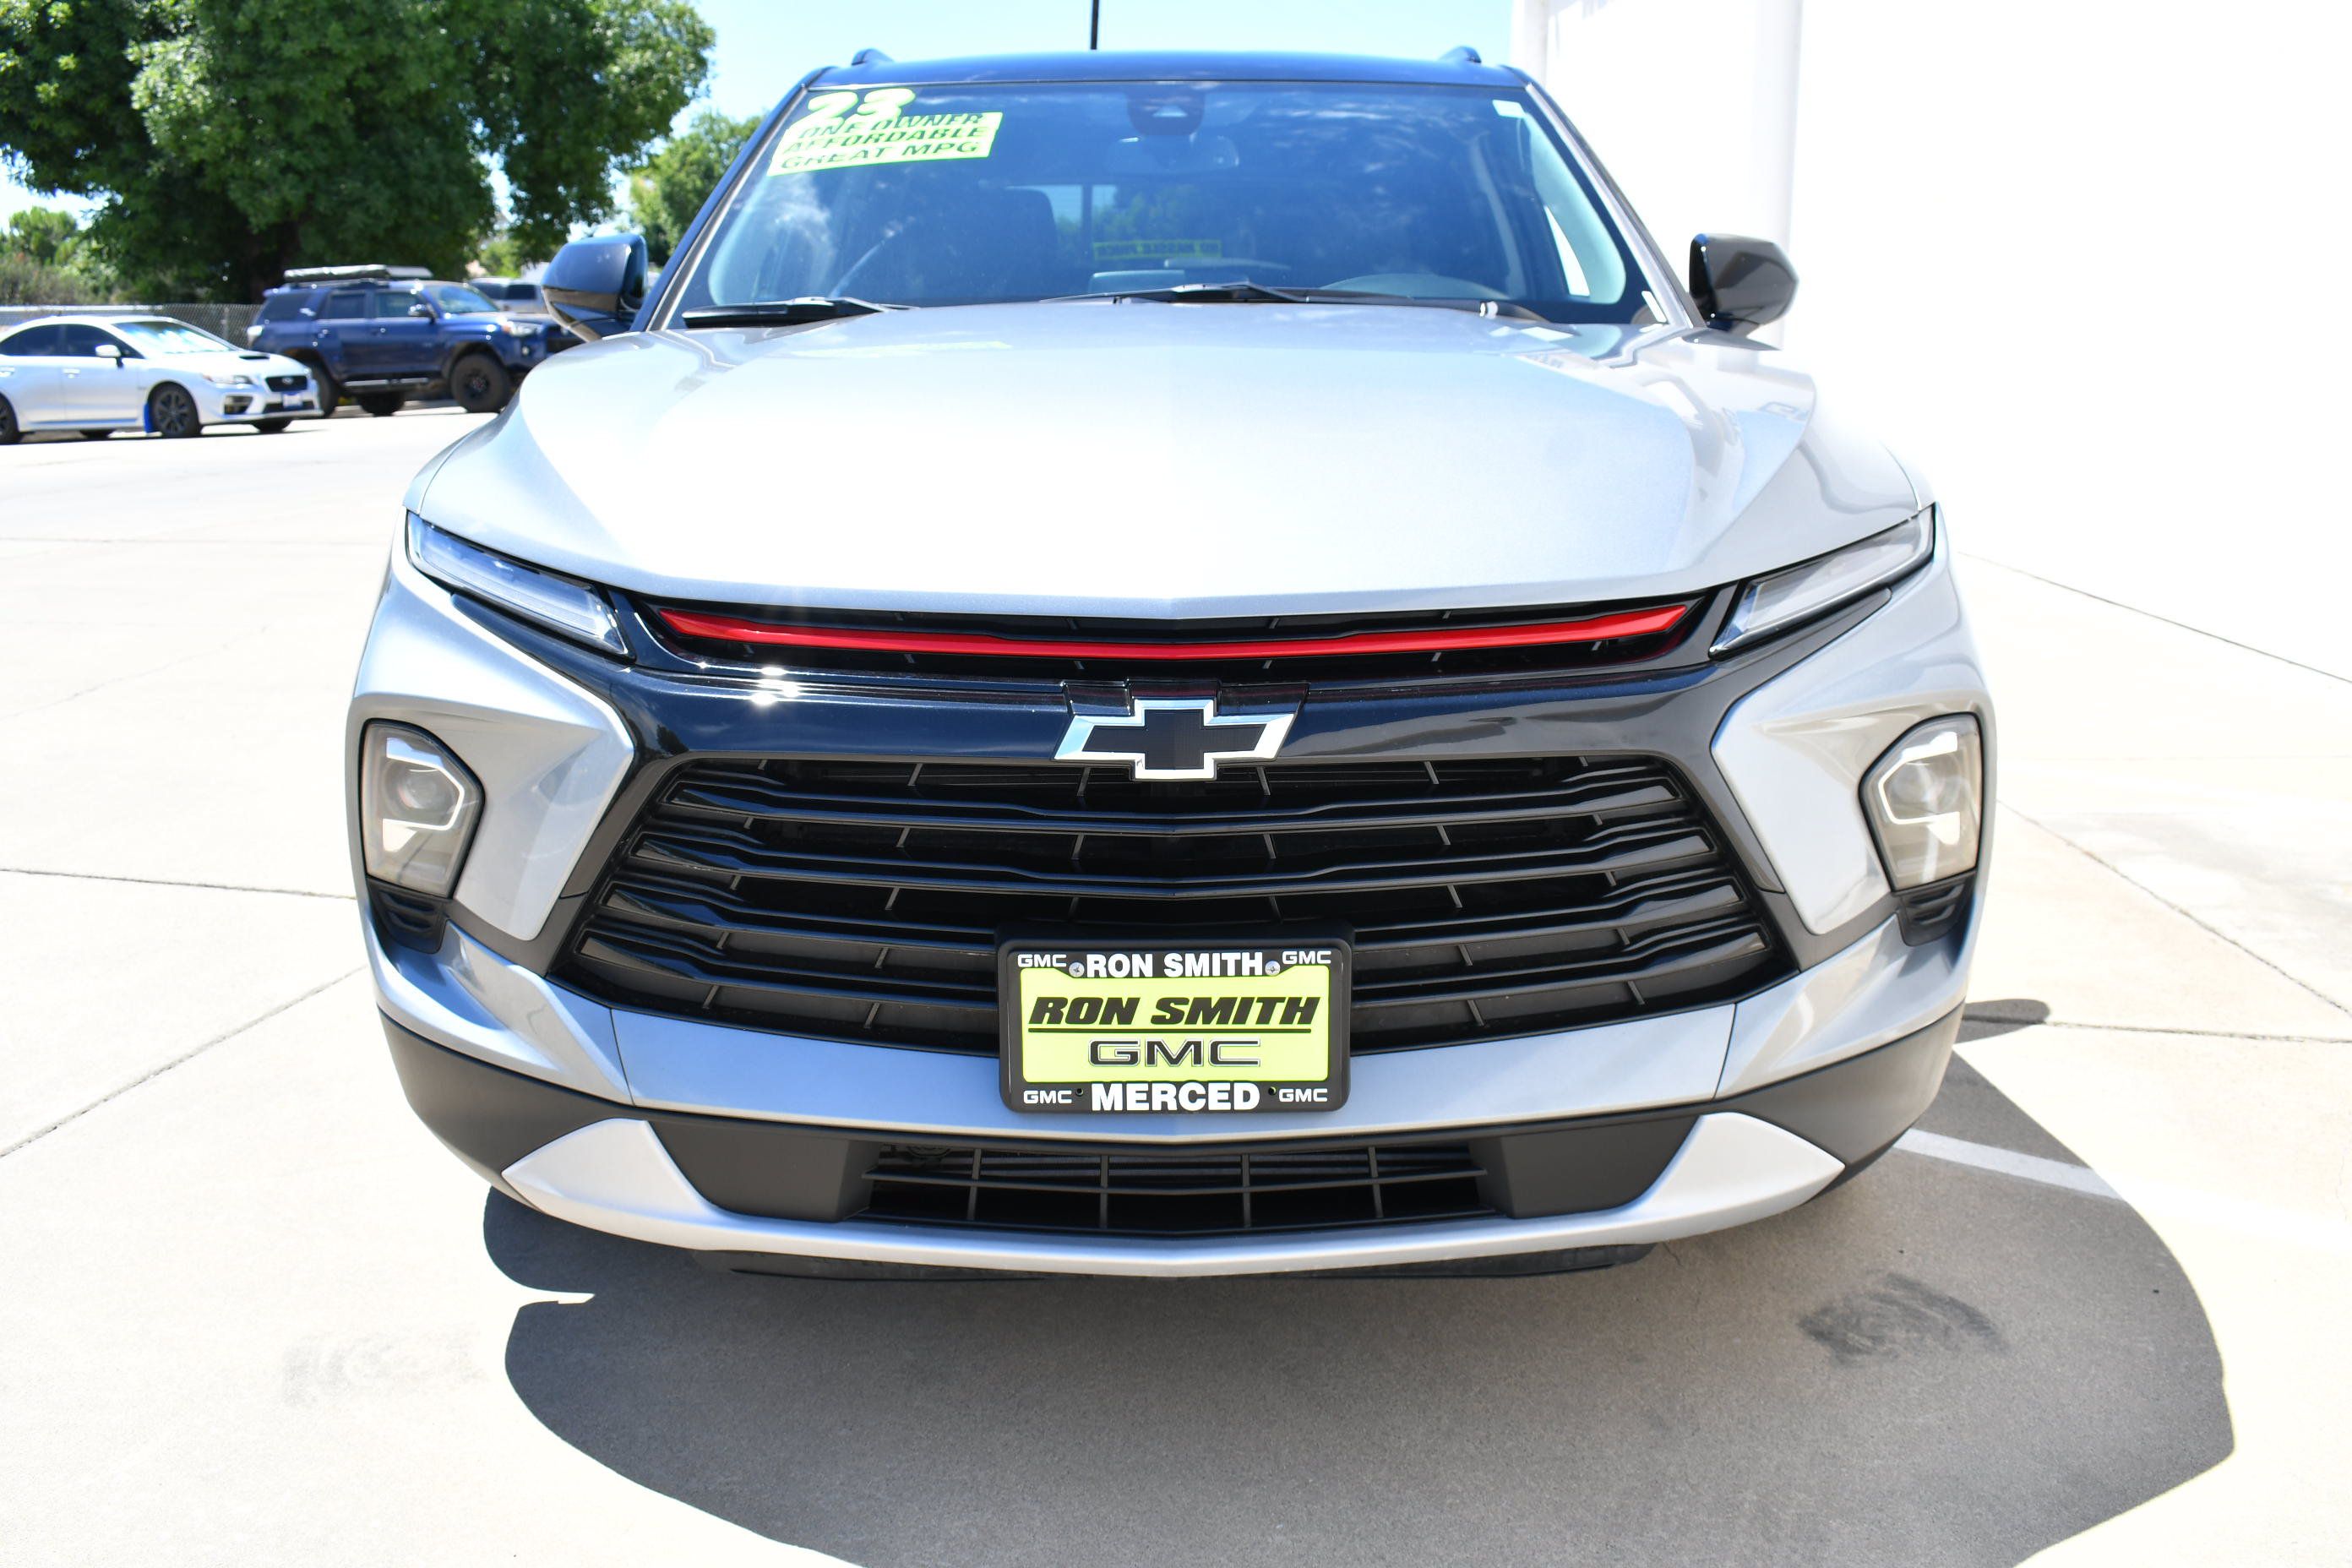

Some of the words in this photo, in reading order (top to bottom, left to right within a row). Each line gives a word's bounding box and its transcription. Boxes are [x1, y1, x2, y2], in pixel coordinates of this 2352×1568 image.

[794, 88, 916, 127] 23
[799, 122, 865, 139] ONE
[870, 112, 984, 130] OWNER
[781, 146, 892, 168] GREAT
[901, 141, 978, 155] MPG
[782, 128, 988, 154] AFFORDABLE
[1017, 953, 1067, 967] GMC
[1086, 952, 1153, 978] RON
[1163, 951, 1263, 977] SMITH
[1282, 950, 1332, 965] GMC
[1028, 996, 1141, 1025] RON
[1151, 996, 1320, 1025] SMITH
[1088, 1038, 1261, 1067] GMC
[1023, 1089, 1073, 1104] GMC
[1091, 1081, 1260, 1112] MERCED
[1278, 1087, 1328, 1102] GMC
